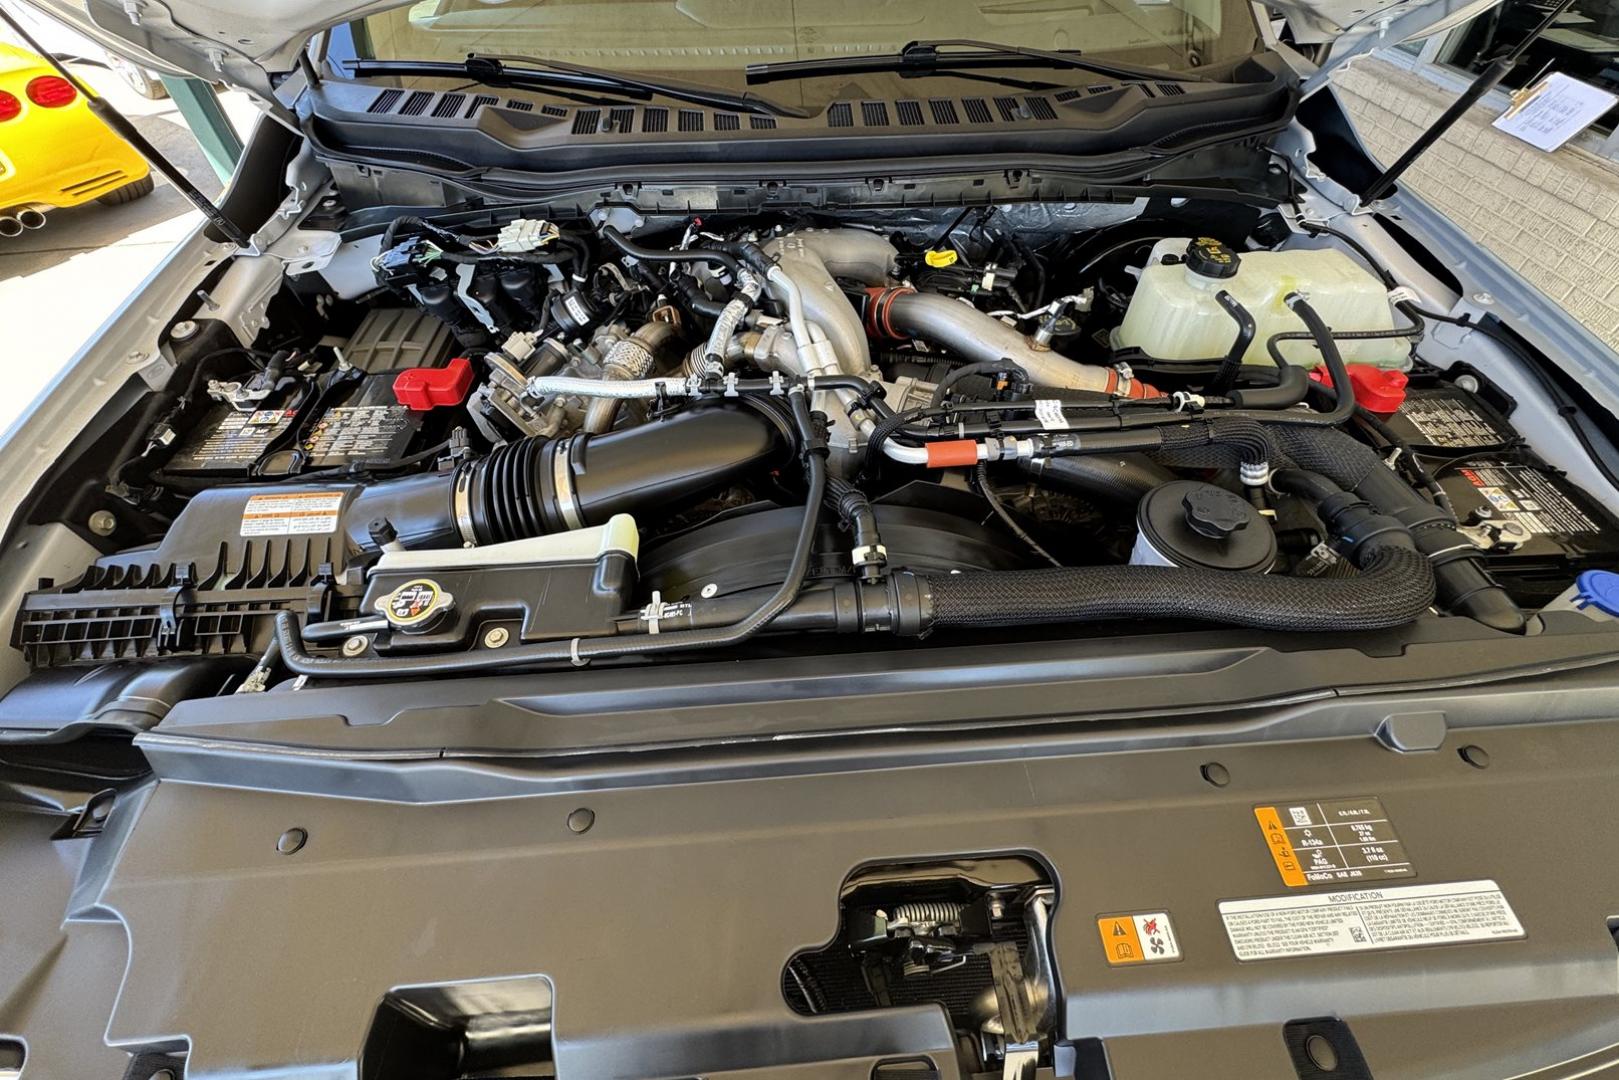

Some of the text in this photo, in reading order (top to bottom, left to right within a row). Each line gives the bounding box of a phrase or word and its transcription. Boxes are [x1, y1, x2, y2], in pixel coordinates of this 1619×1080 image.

[1301, 839, 1324, 847] R-134a
[1306, 872, 1333, 881] FoMoCo
[1328, 891, 1384, 902] MODIFICATION
